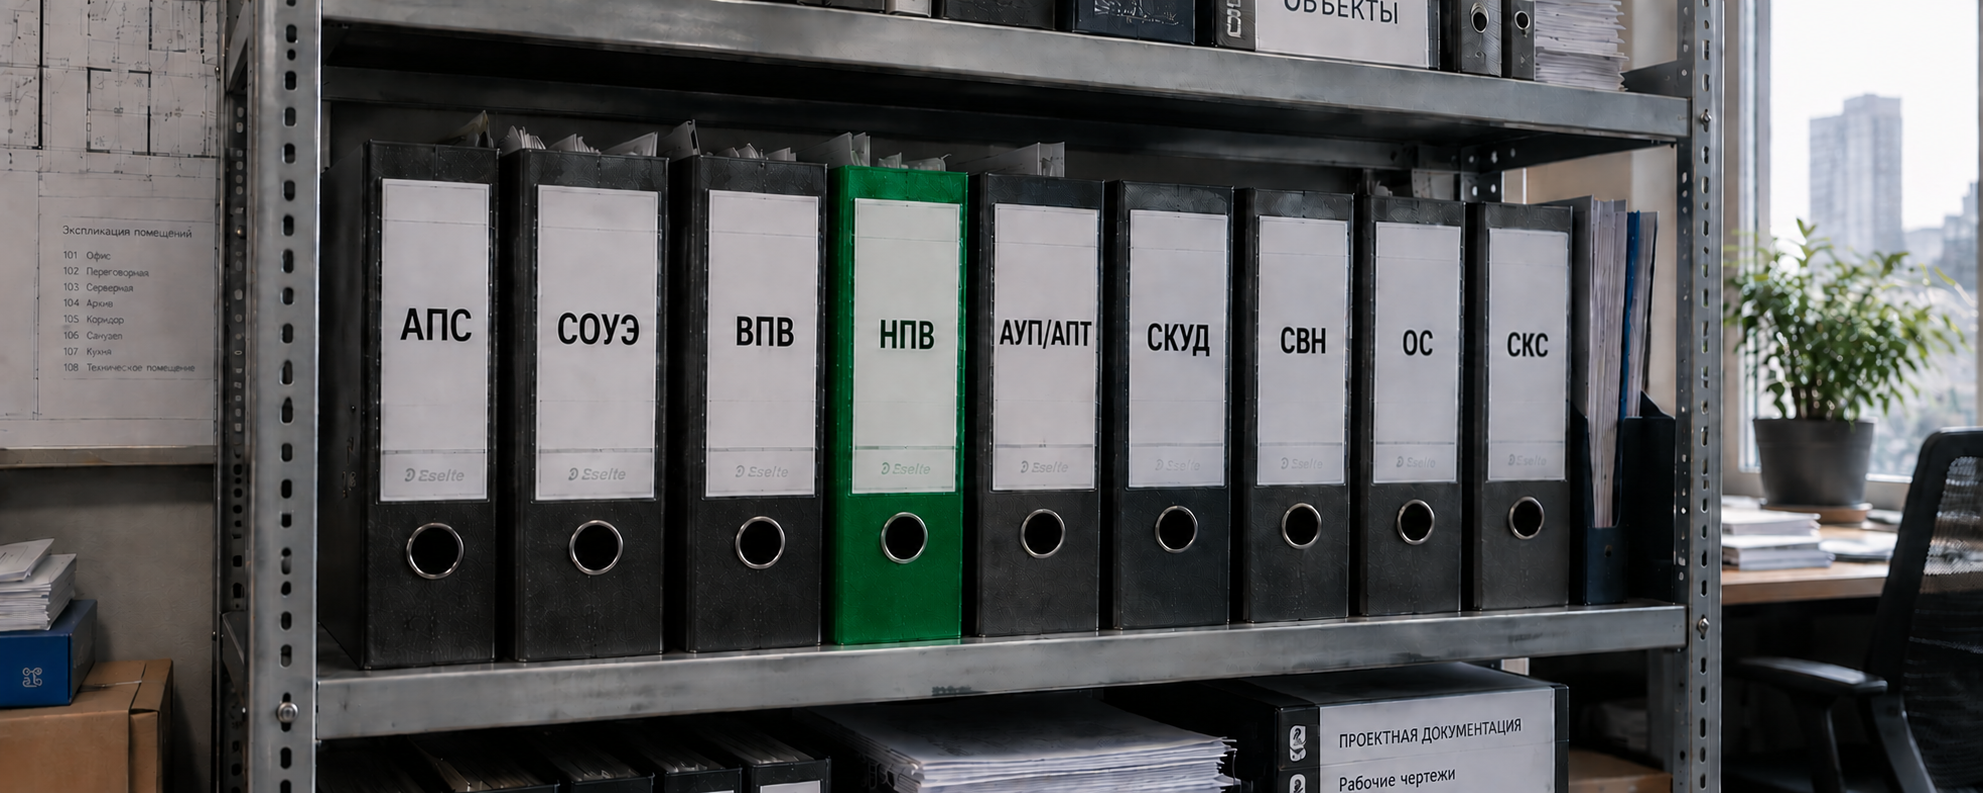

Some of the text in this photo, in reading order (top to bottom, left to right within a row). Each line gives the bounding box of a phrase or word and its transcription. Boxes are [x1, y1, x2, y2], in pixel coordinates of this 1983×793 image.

[134, 226, 192, 239] помещений
[63, 251, 111, 262] 101 Офис
[63, 267, 149, 278] 102 Переговорная
[63, 283, 133, 294] 103 Серверная
[63, 299, 79, 307] 104
[63, 315, 124, 326] 105 Коридор
[400, 308, 472, 342] АПС
[557, 312, 640, 346] СОУЭ
[736, 316, 795, 347] ВПВ
[63, 331, 79, 339] 106
[880, 319, 935, 350] НПВ
[1000, 319, 1092, 350] АУП/АПТ
[1147, 322, 1211, 357] СКУД
[1280, 326, 1327, 355] СВН
[1402, 329, 1434, 357] ОС
[1507, 331, 1549, 358] СКС
[63, 347, 112, 358] 107 Кухня
[63, 363, 195, 373] 108 Техническое помещение
[1339, 718, 1522, 749] ПРОЕКТНАЯ ДОКУМЕНТАЦИЯ
[1339, 768, 1456, 792] Рабочие чертежи
